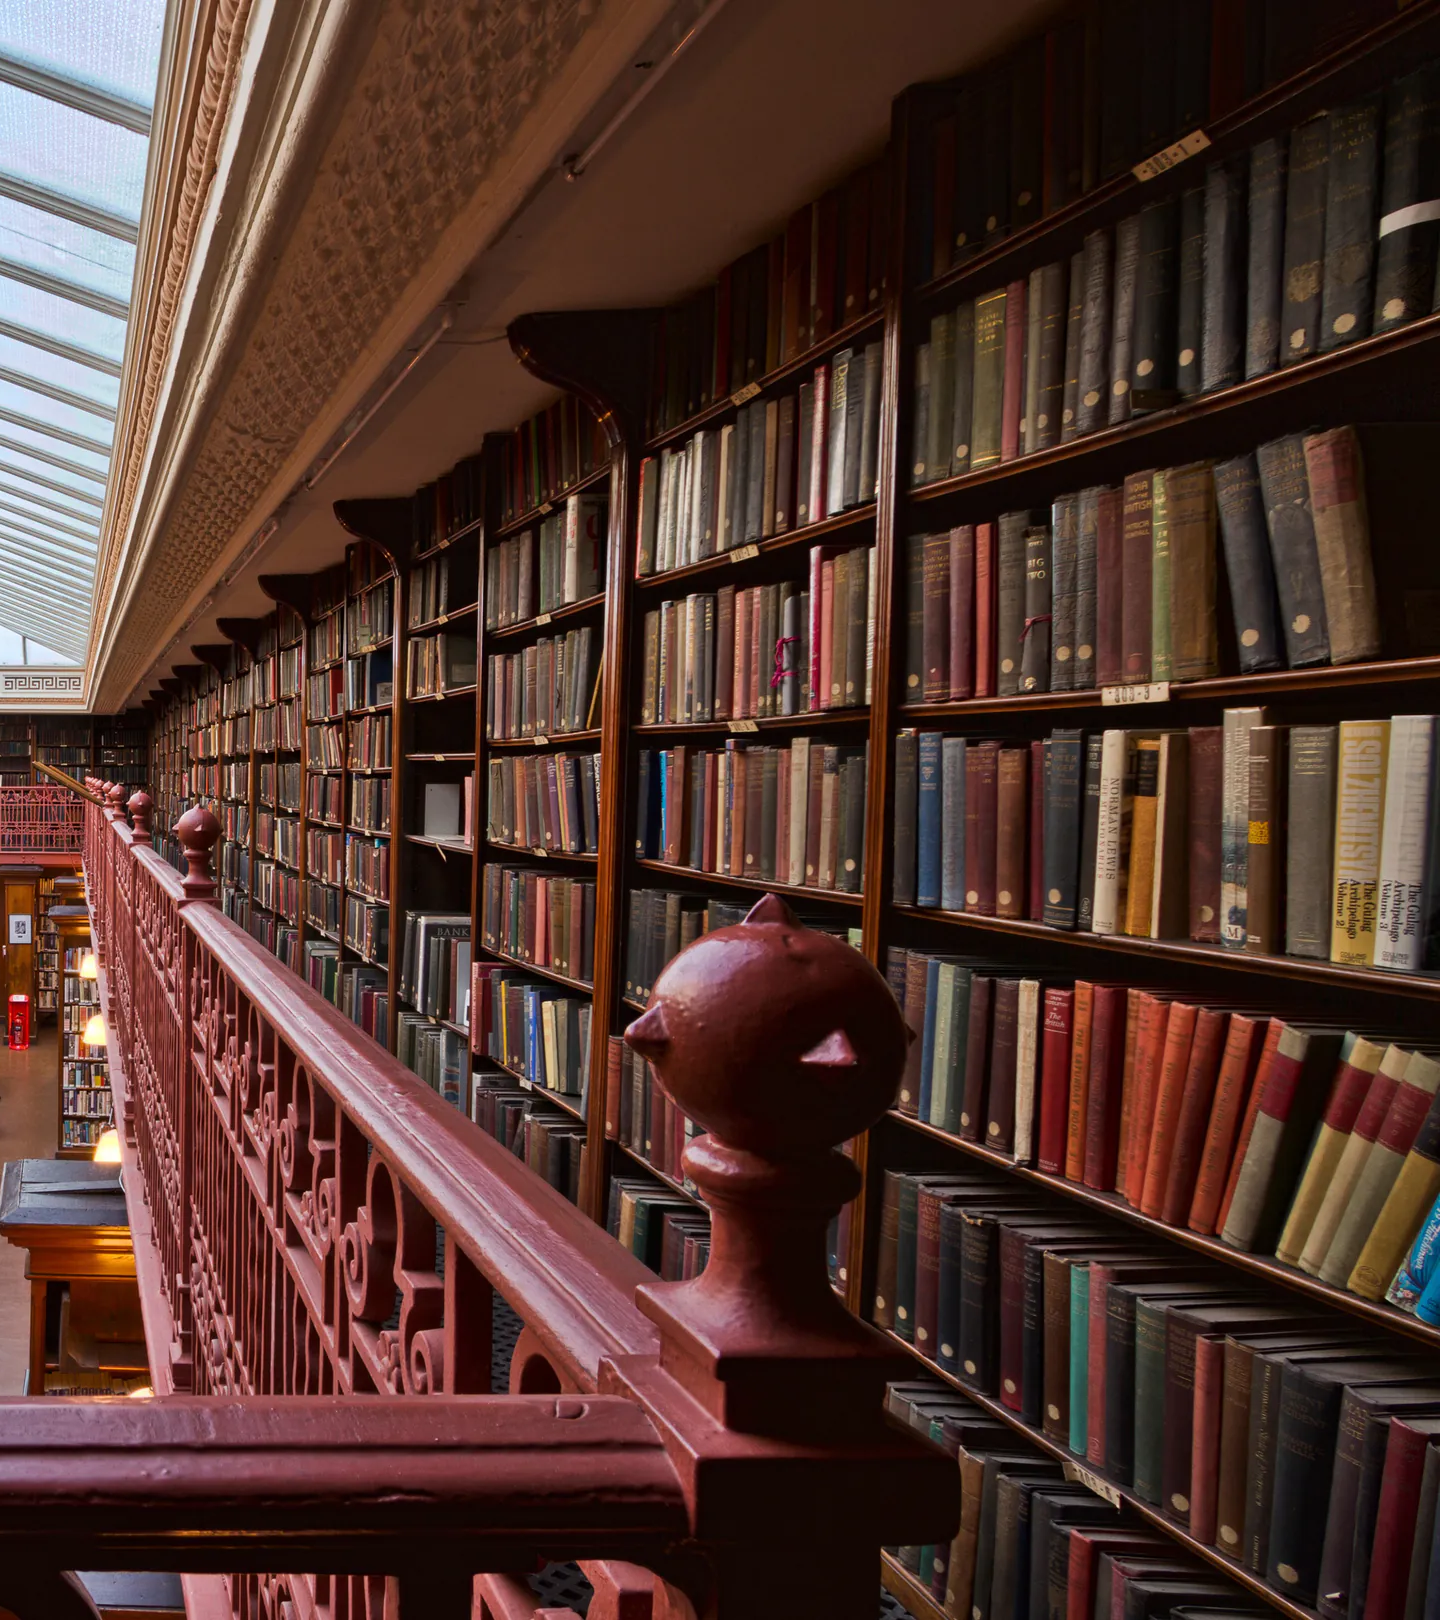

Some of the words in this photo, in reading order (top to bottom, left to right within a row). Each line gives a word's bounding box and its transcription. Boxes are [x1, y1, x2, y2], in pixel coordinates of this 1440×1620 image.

[1108, 778, 1120, 835] NORMAN
[1105, 840, 1118, 881] LEWIS
[1363, 880, 1376, 900] The
[1407, 881, 1422, 904] The
[1346, 878, 1360, 940] Archipelago
[1360, 902, 1376, 933] Gulag
[1388, 880, 1405, 943] Archipelago
[1403, 904, 1421, 937] Gulag
[437, 927, 469, 937] BANK
[1049, 1011, 1062, 1021] The
